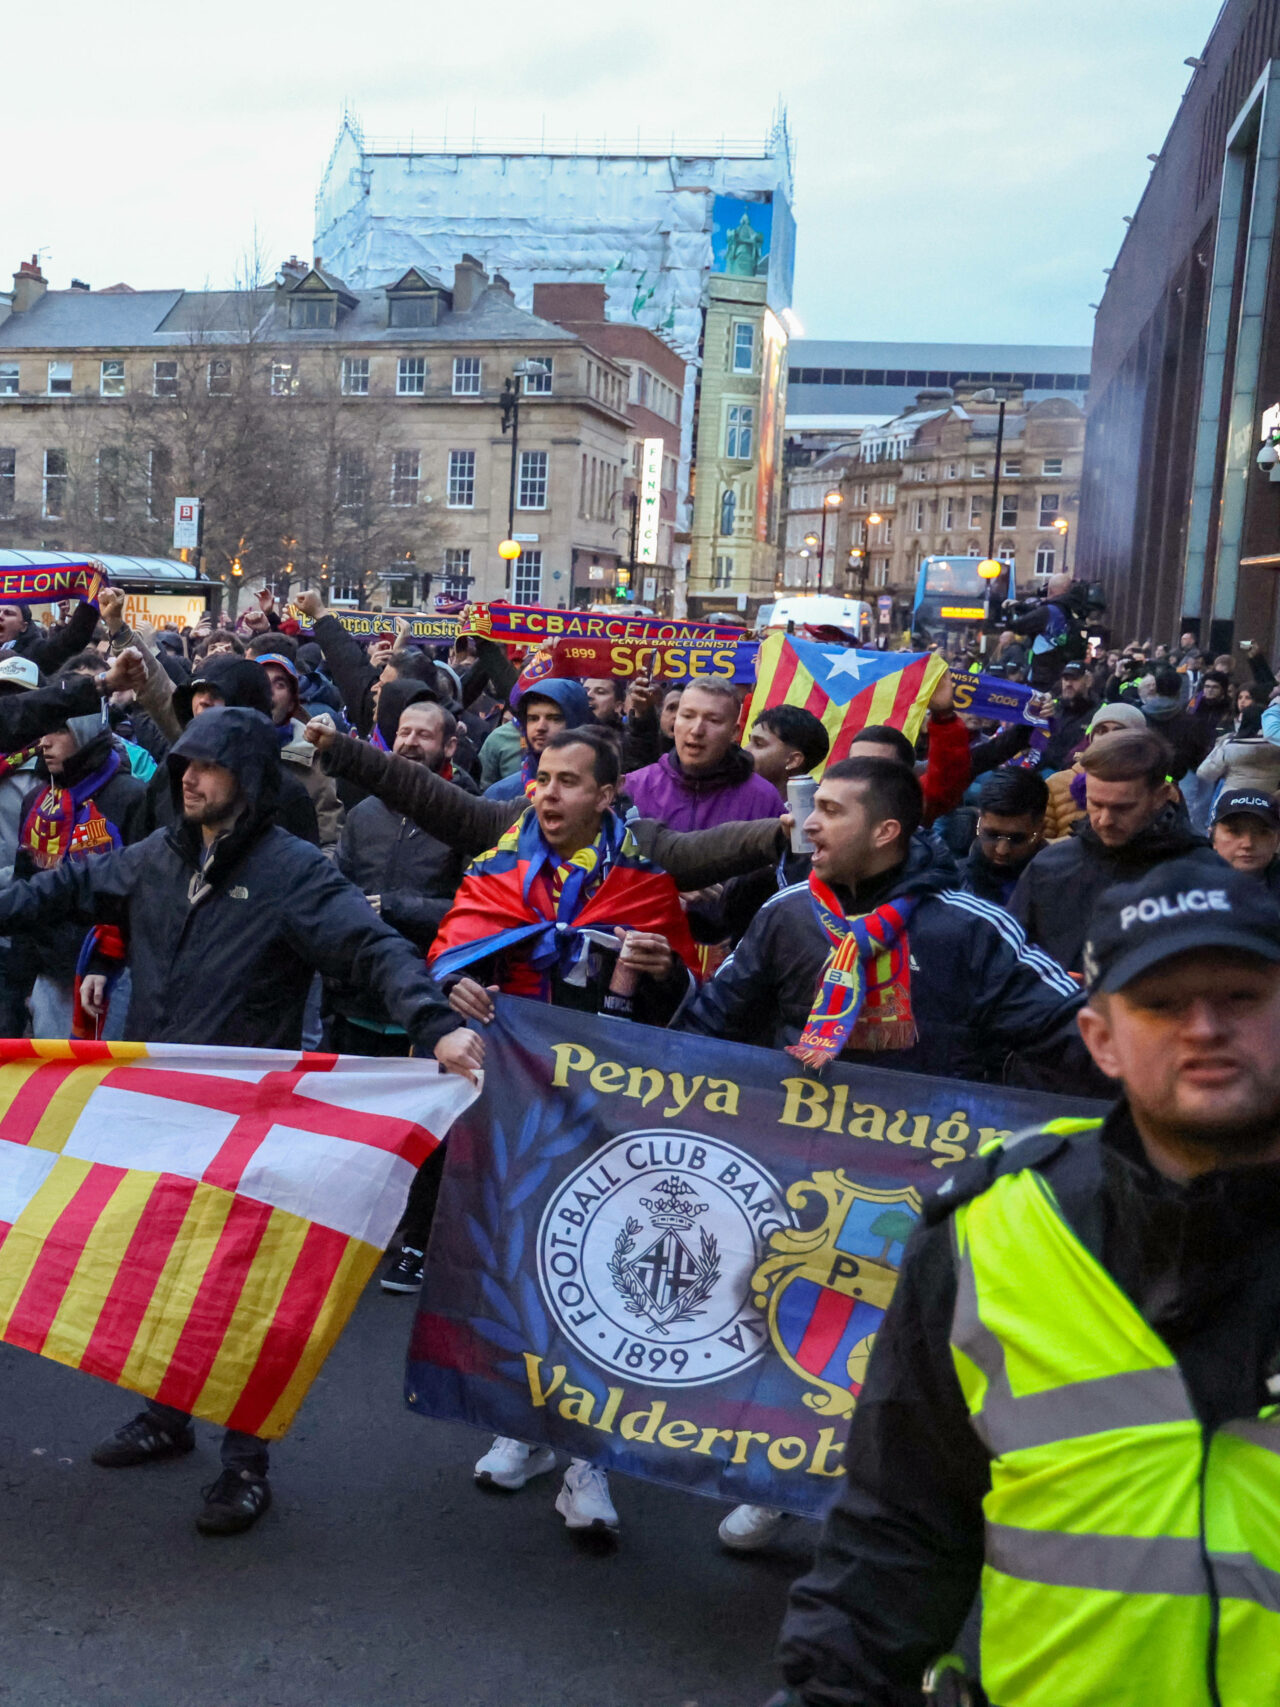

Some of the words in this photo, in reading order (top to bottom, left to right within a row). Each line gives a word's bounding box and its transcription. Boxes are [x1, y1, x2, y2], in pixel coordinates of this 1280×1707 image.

[642, 448, 656, 556] FENWICK
[125, 595, 150, 613] ALL
[564, 647, 597, 660] 1899
[651, 639, 739, 649] BARCELONISTA
[610, 646, 736, 680] SOSES
[1230, 796, 1269, 808] POLICE
[1120, 888, 1232, 931] POLICE
[550, 1042, 741, 1118] Penya
[550, 1164, 622, 1328] FOOT-BALL
[625, 1140, 708, 1171] CLUB
[612, 1336, 690, 1376] 1899
